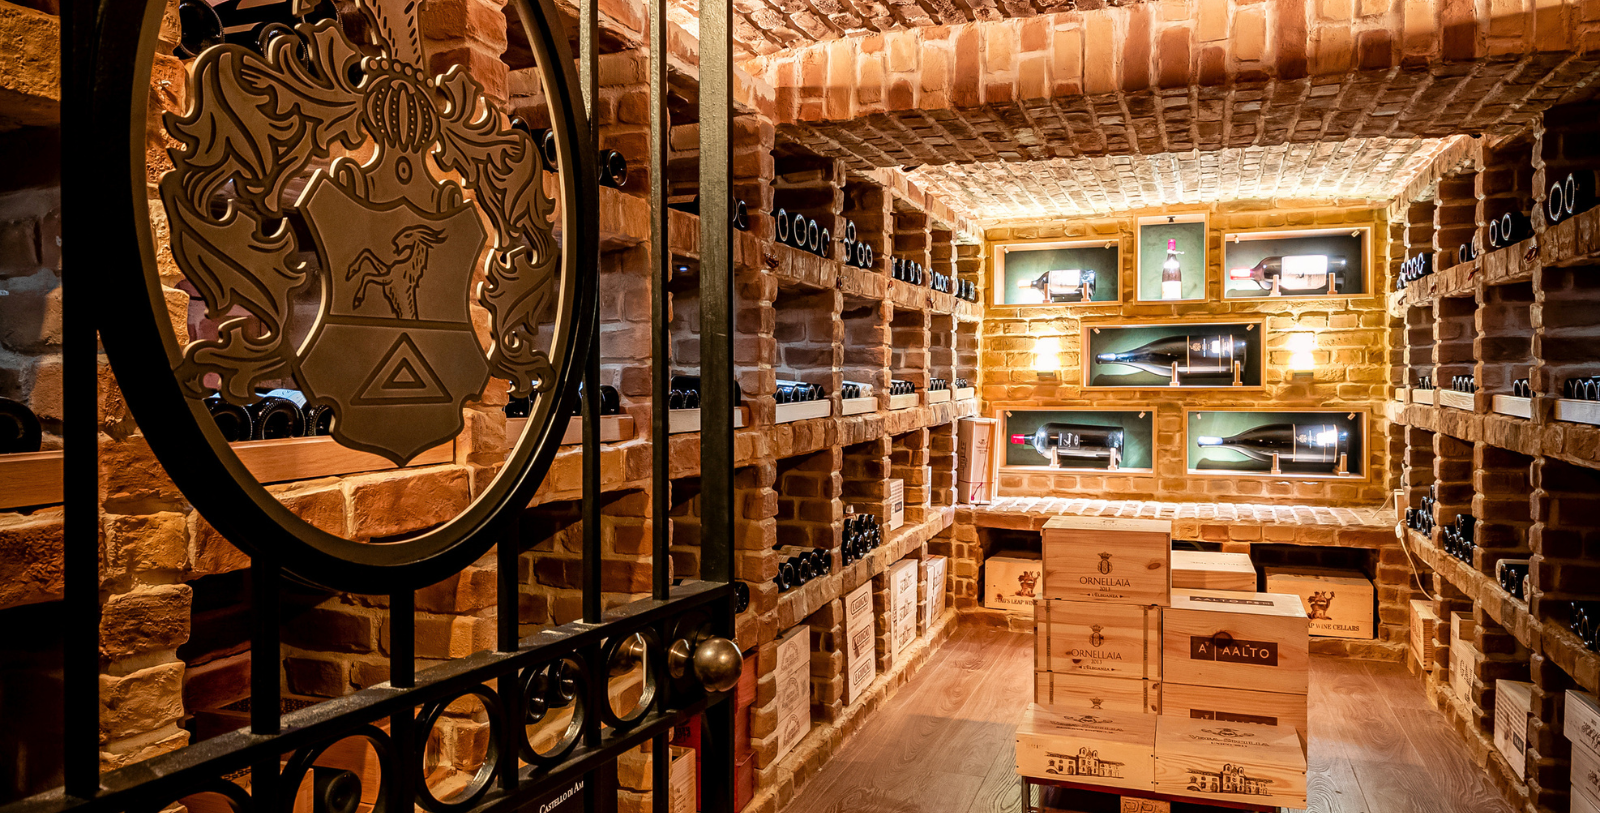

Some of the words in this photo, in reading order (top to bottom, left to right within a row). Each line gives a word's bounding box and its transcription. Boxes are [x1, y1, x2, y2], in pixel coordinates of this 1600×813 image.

[1079, 576, 1131, 587] ORNELLAIA
[1071, 649, 1122, 660] ORNELLAIA
[1222, 645, 1270, 659] AALTO
